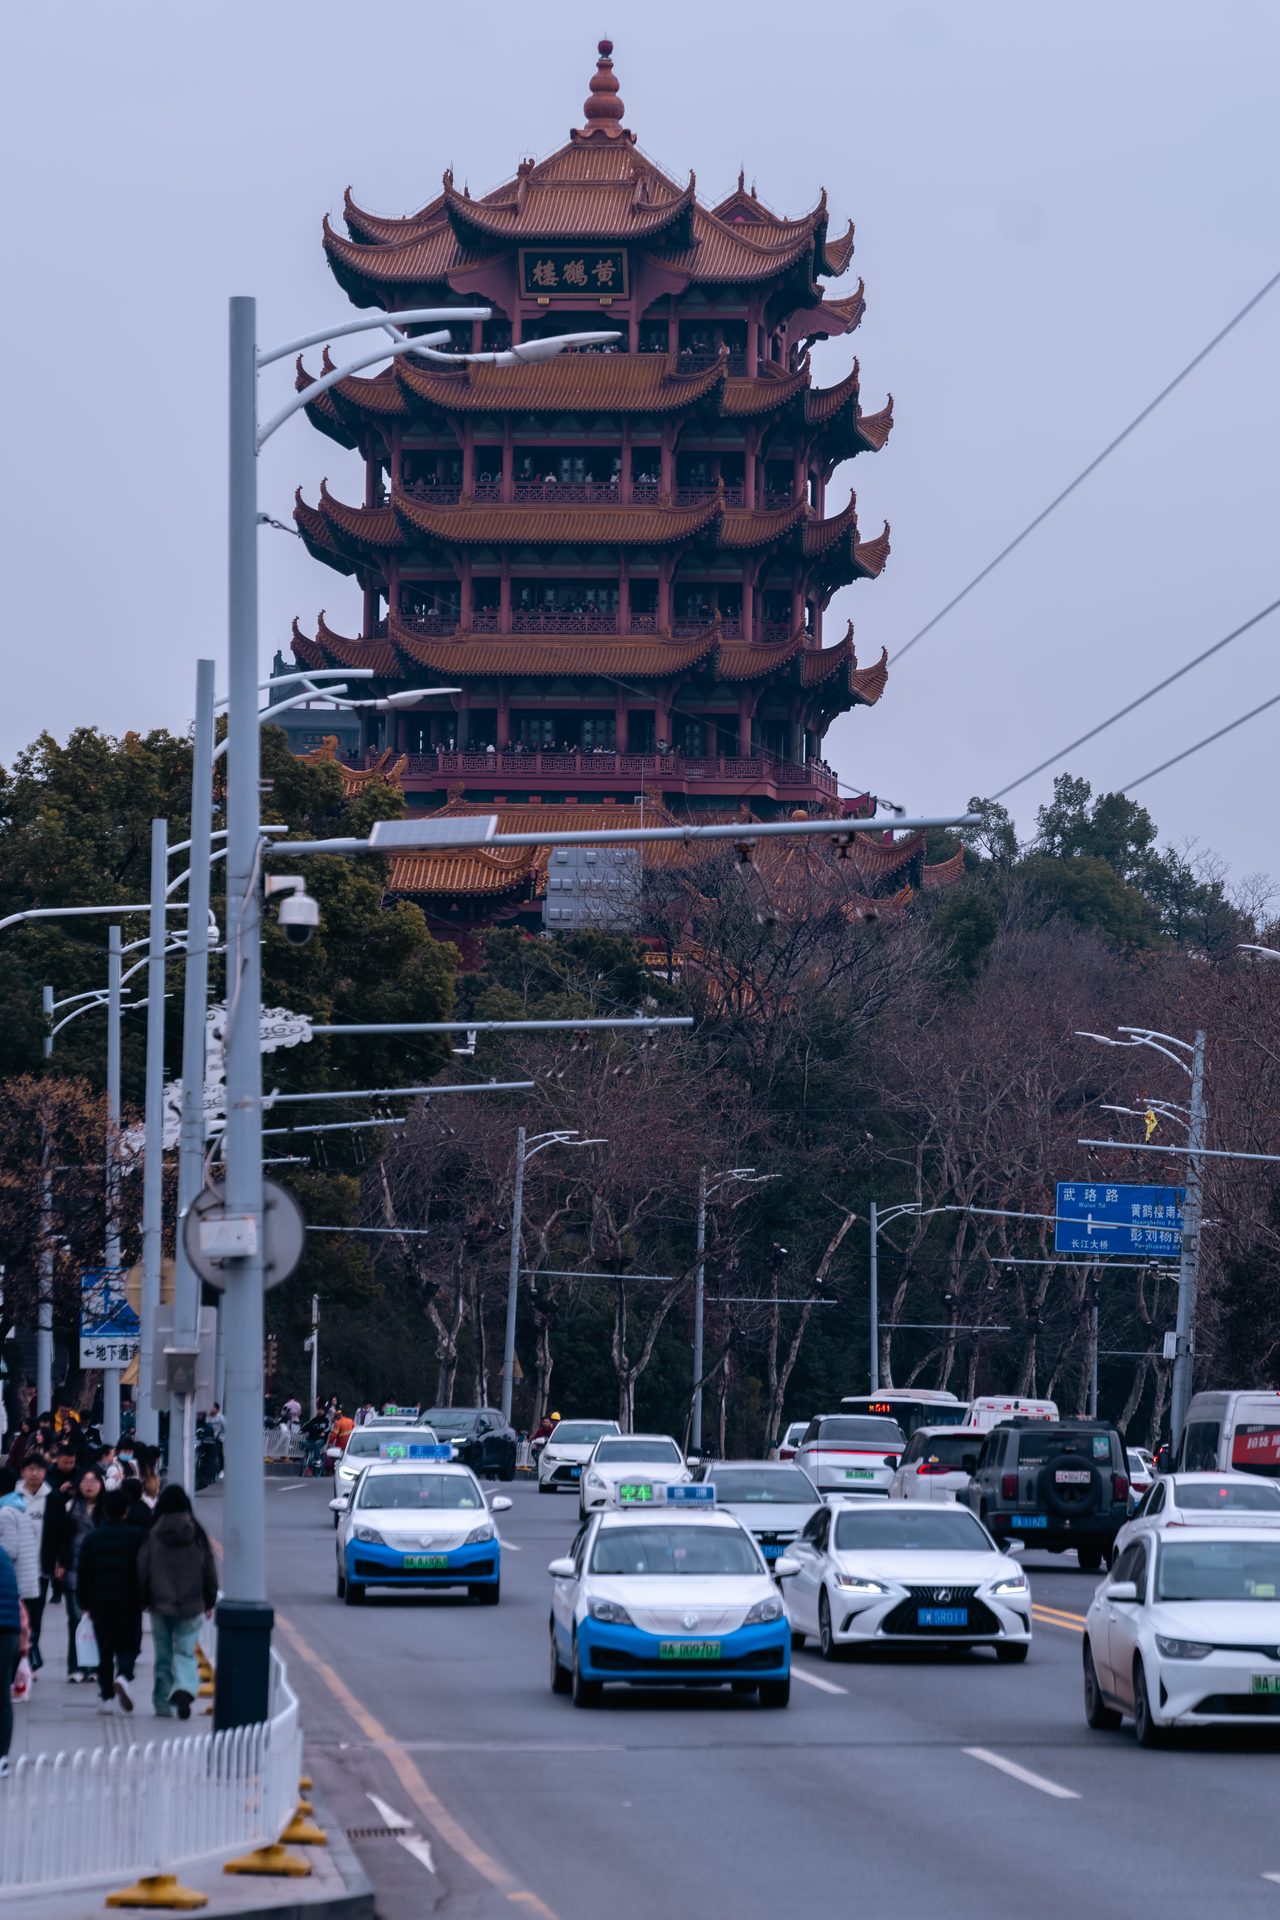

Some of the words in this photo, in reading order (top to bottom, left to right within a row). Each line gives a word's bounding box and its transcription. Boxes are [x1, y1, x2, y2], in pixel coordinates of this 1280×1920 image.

[1063, 1187, 1119, 1203] 武珞路
[1071, 1238, 1109, 1250] 长江大桥
[620, 1484, 652, 1503] 空车
